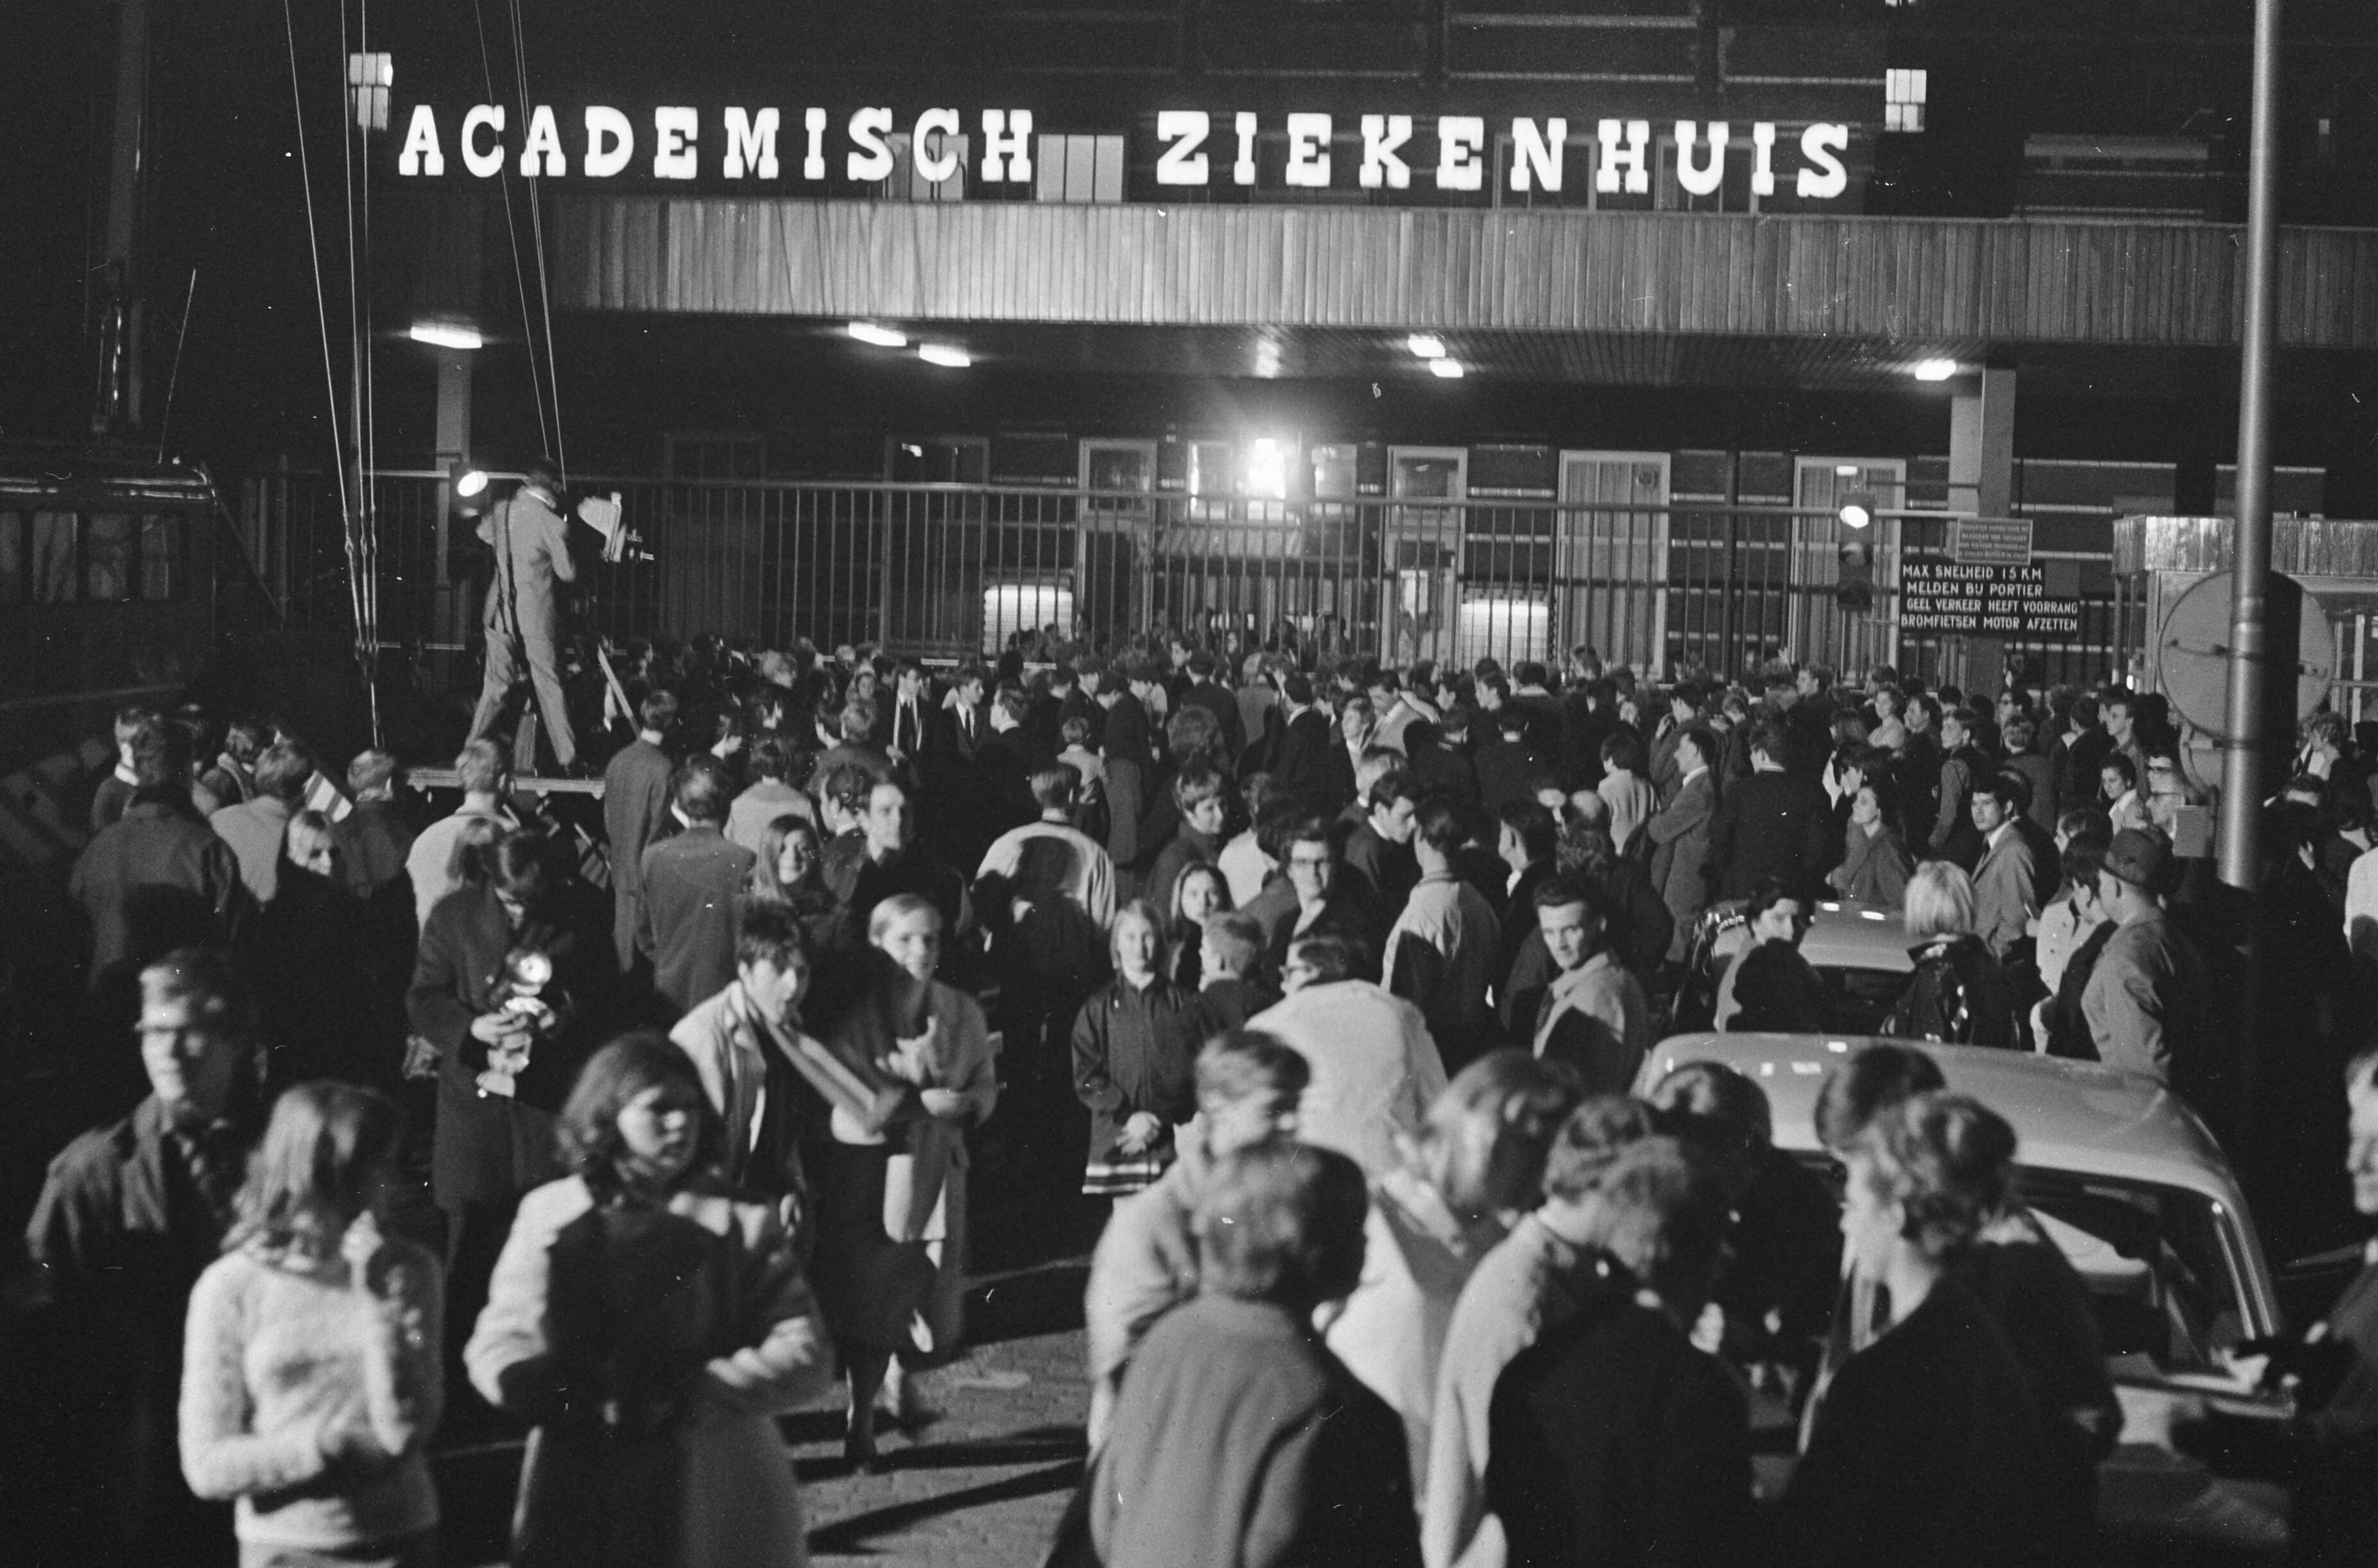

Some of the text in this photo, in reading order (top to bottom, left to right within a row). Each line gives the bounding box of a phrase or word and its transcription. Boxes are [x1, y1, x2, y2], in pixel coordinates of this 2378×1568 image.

[399, 105, 1847, 199] ACADEMISCH ZIEKENHUIS
[1935, 565, 1994, 580] SNELHEID
[2003, 566, 2016, 581] 15
[2021, 567, 2042, 580] KM
[1907, 581, 1959, 596] MELDEN
[1990, 583, 2042, 598] PORTIER
[1907, 598, 2078, 615] GEEL VERKEER HEEFT VOORRANG
[1900, 614, 2078, 632] BROMFIETSEN MOTOR AFZETTEN
